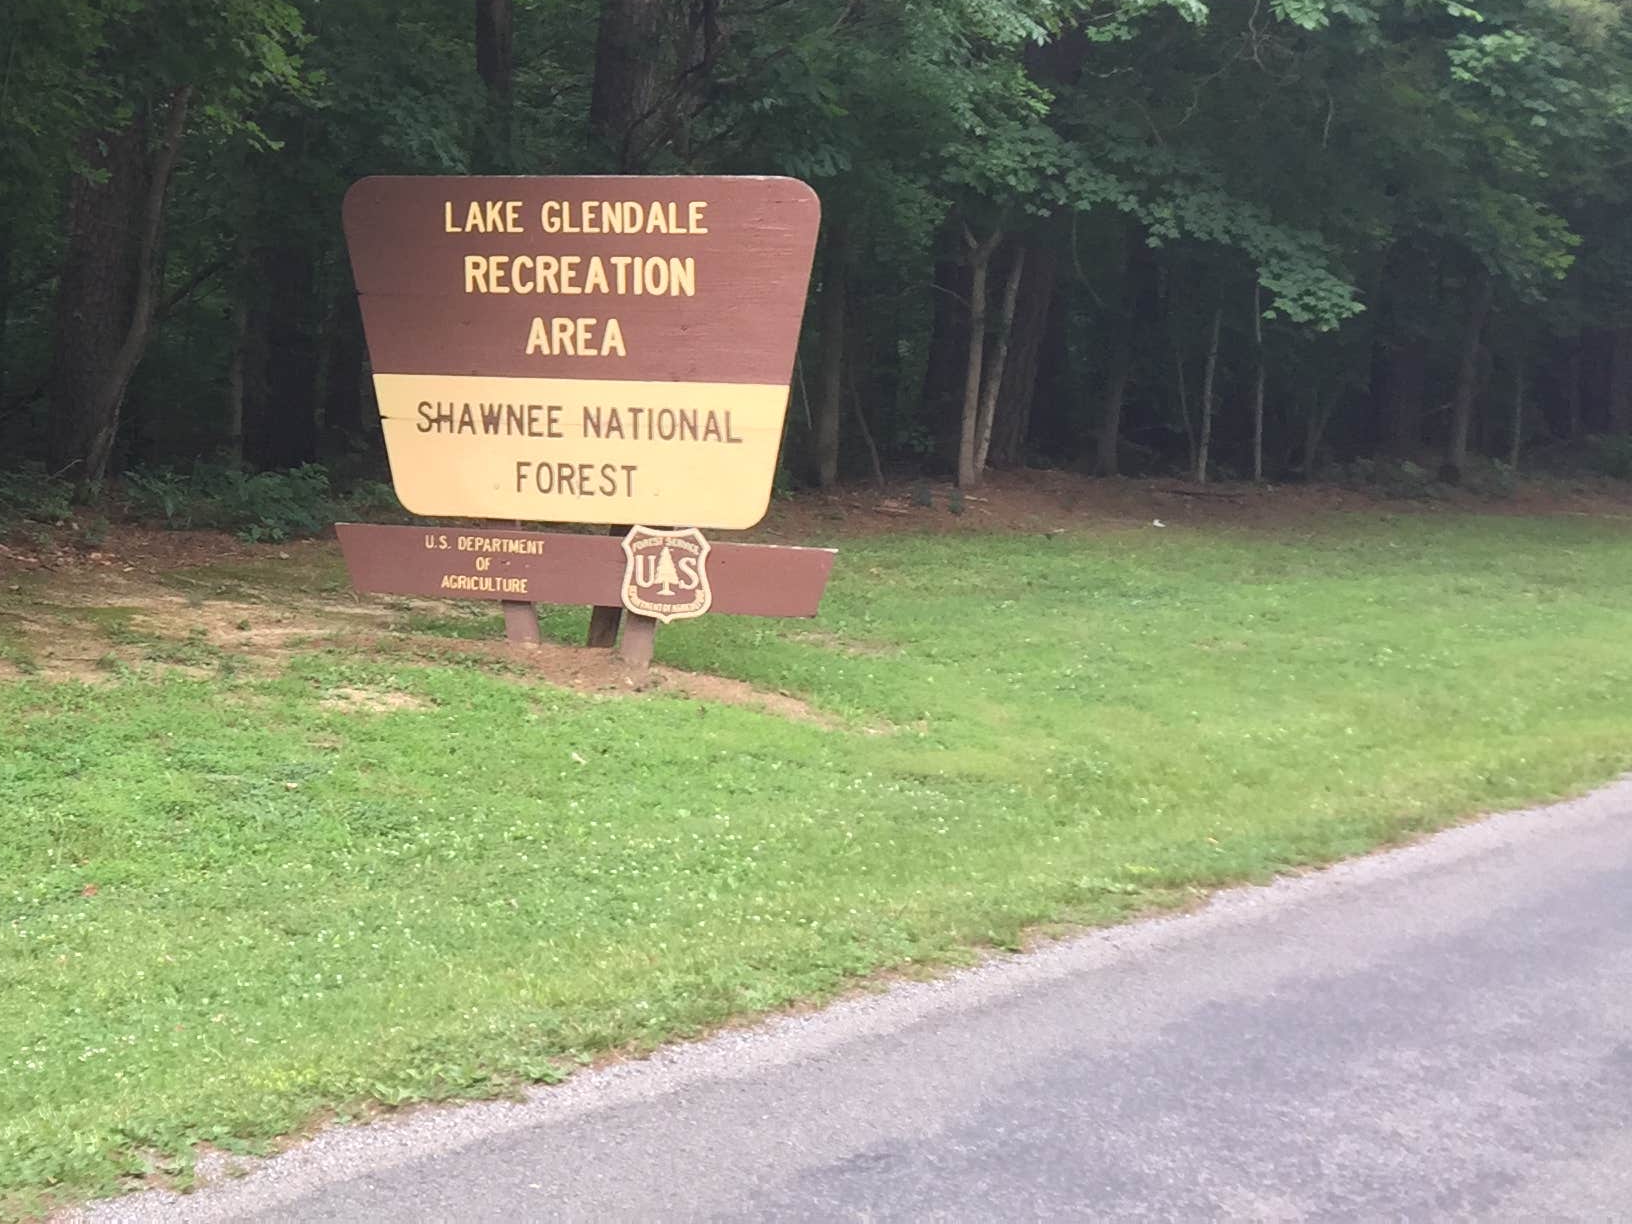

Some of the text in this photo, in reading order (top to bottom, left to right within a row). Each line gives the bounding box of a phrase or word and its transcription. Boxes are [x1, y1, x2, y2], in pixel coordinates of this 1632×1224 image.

[444, 200, 709, 235] LAKE GLENDALE
[464, 255, 696, 297] RECREATION
[525, 317, 627, 357] AREA
[415, 401, 743, 444] SHAWNEE NATIONAL
[516, 462, 638, 497] FOREST
[424, 535, 545, 554] U.S. DEPARTMENT
[475, 557, 491, 571] OF
[440, 575, 529, 594] AGRICULTURE
